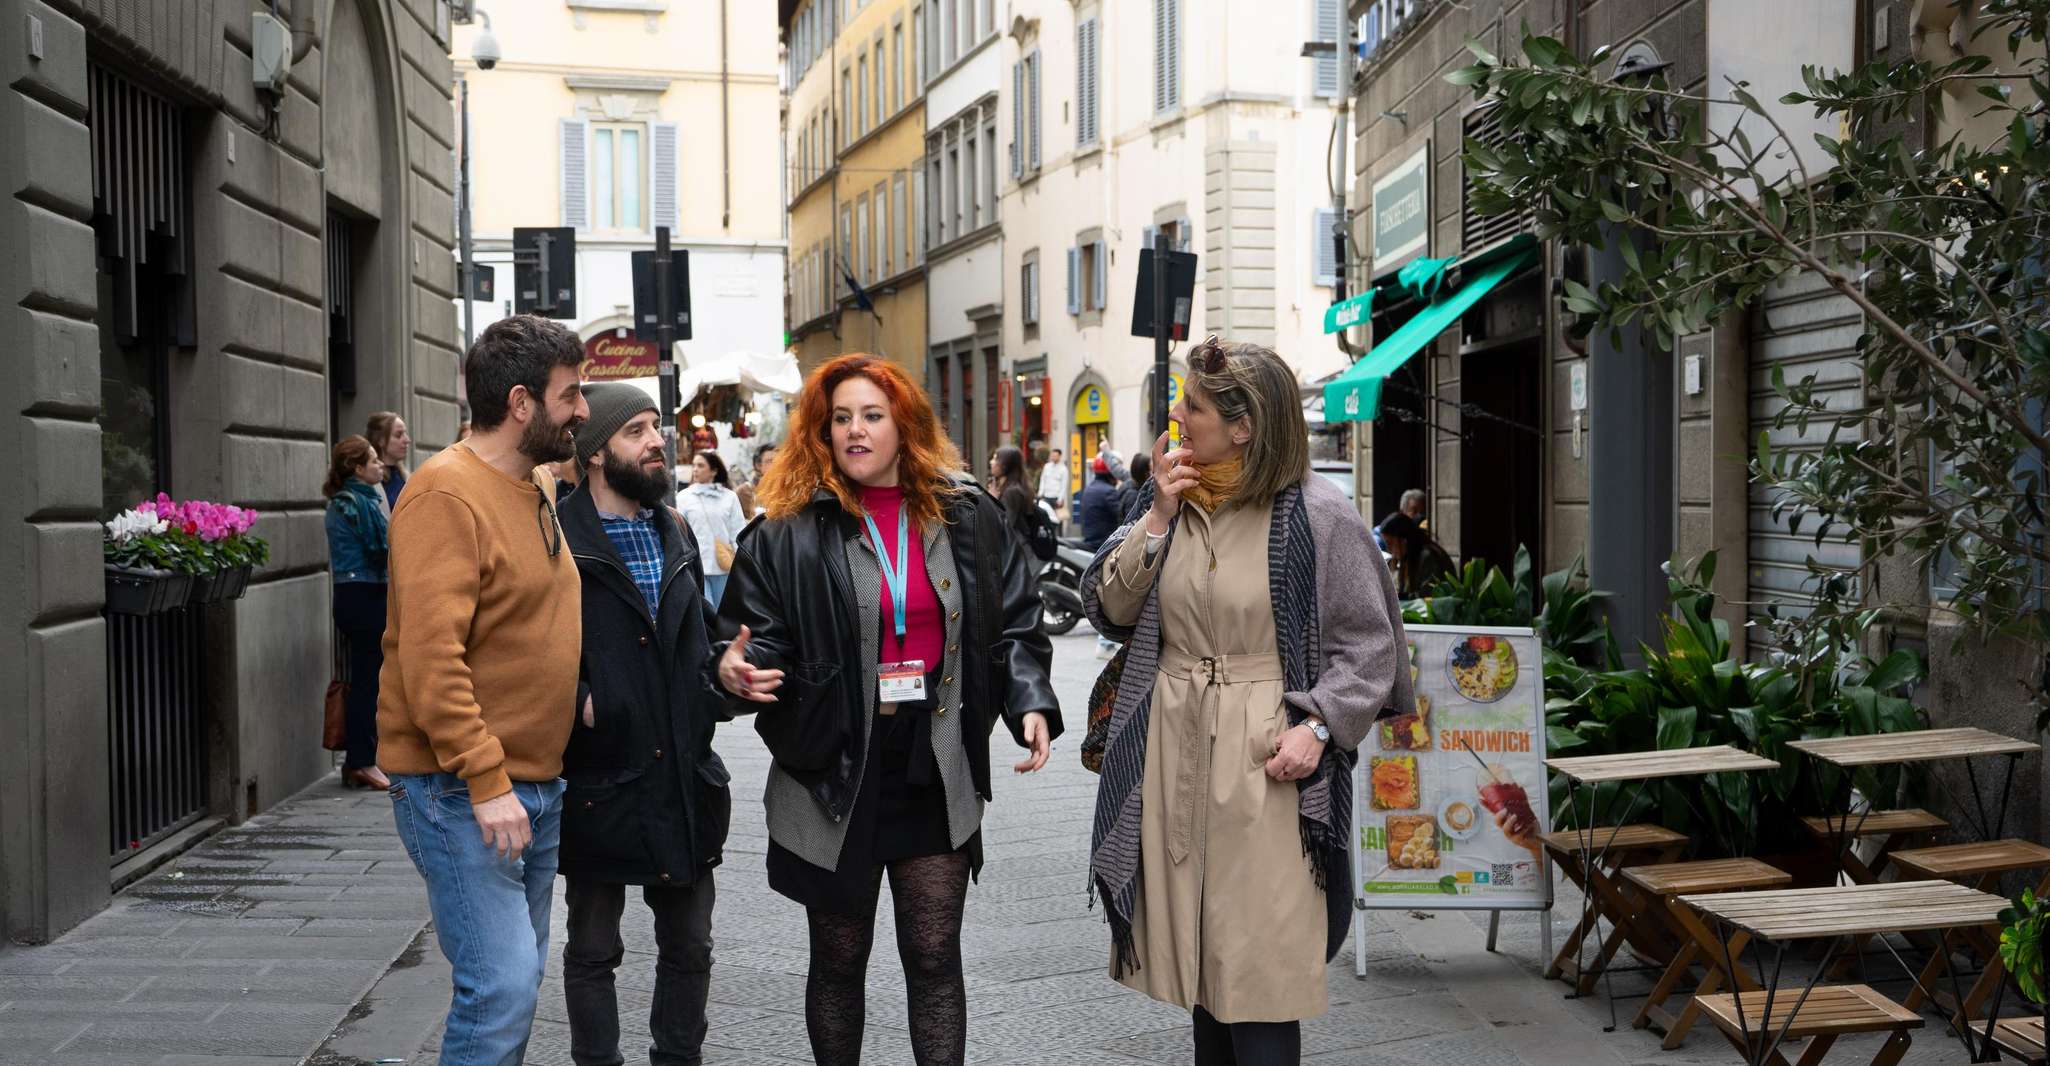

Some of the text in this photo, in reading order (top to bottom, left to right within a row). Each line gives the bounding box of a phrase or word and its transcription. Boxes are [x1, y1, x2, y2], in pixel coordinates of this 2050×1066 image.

[595, 339, 647, 356] Cucina
[578, 356, 657, 382] Casalinga
[1071, 449, 1080, 480] ATM
[1440, 729, 1530, 753] SANDWICH
